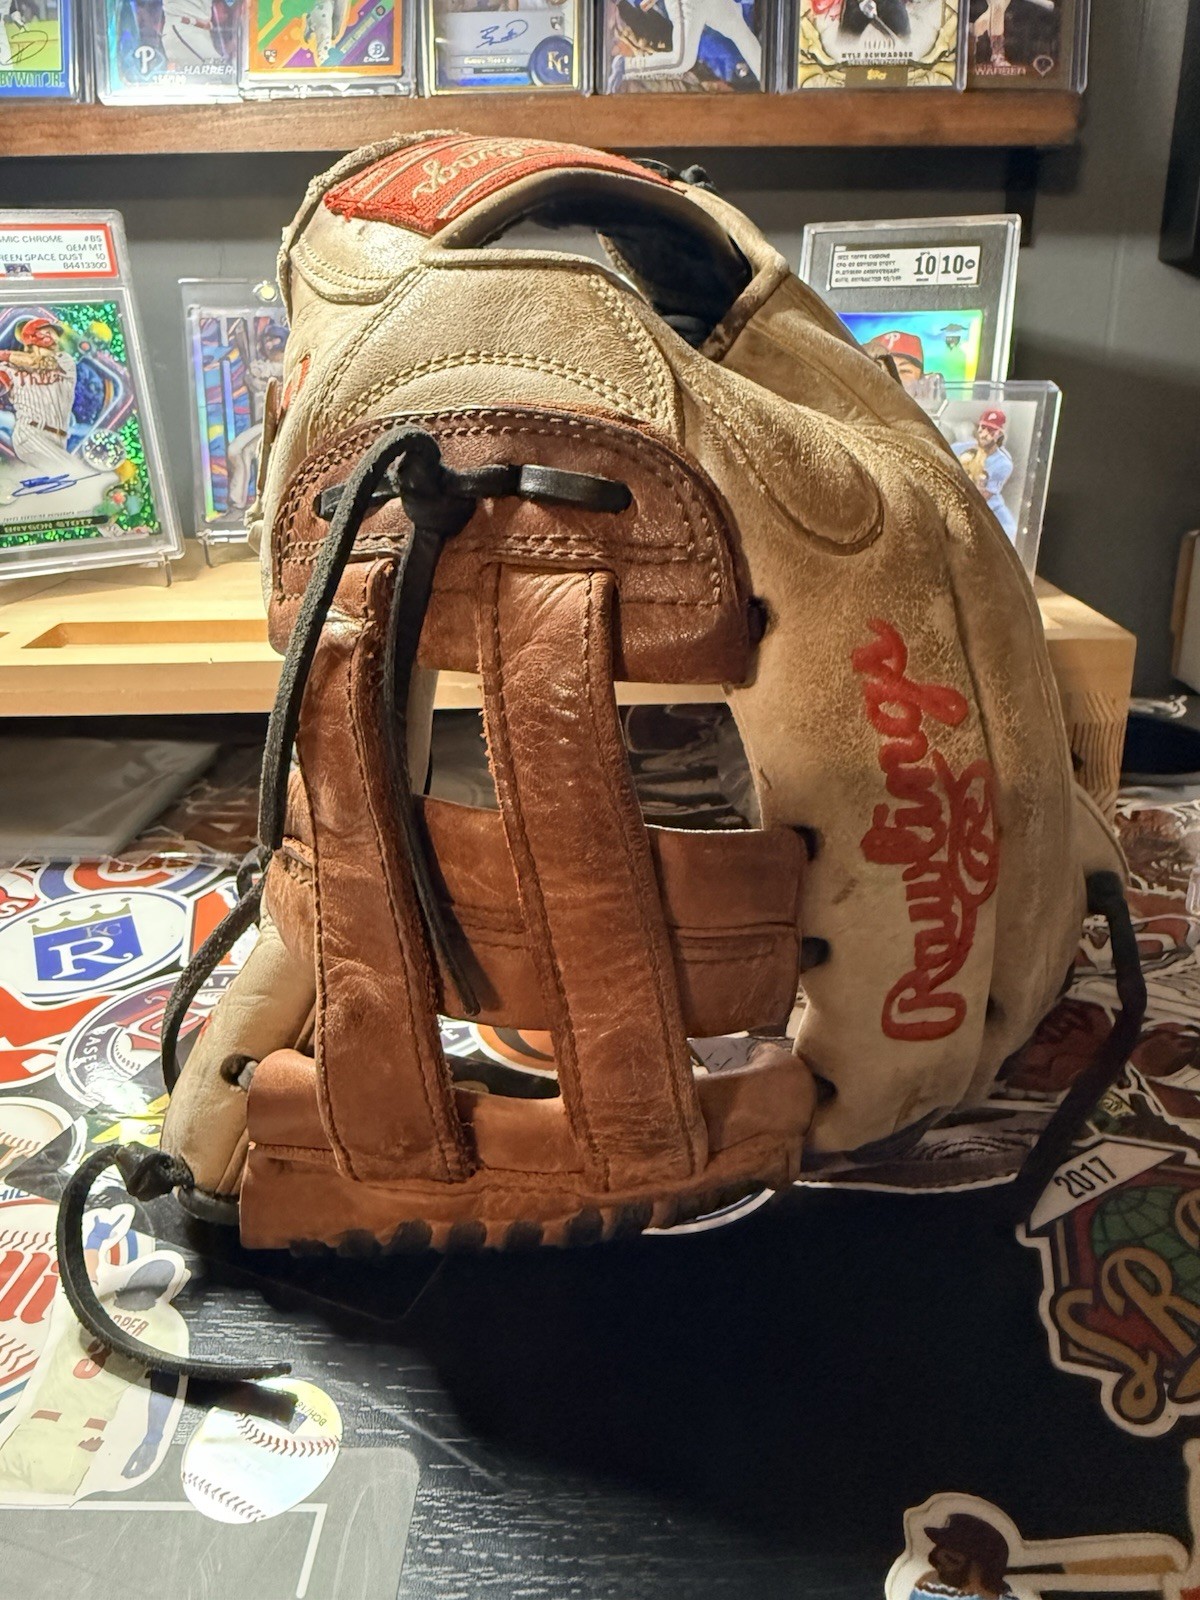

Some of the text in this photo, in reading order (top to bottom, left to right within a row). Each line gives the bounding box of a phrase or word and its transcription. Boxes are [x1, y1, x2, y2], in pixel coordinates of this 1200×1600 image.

[22, 235, 63, 243] CHROME
[25, 253, 56, 261] SPACE
[914, 256, 936, 275] 10
[941, 254, 964, 274] 10
[851, 617, 998, 1042] Rawlings
[48, 936, 134, 980] R
[1054, 1155, 1116, 1199] 2017
